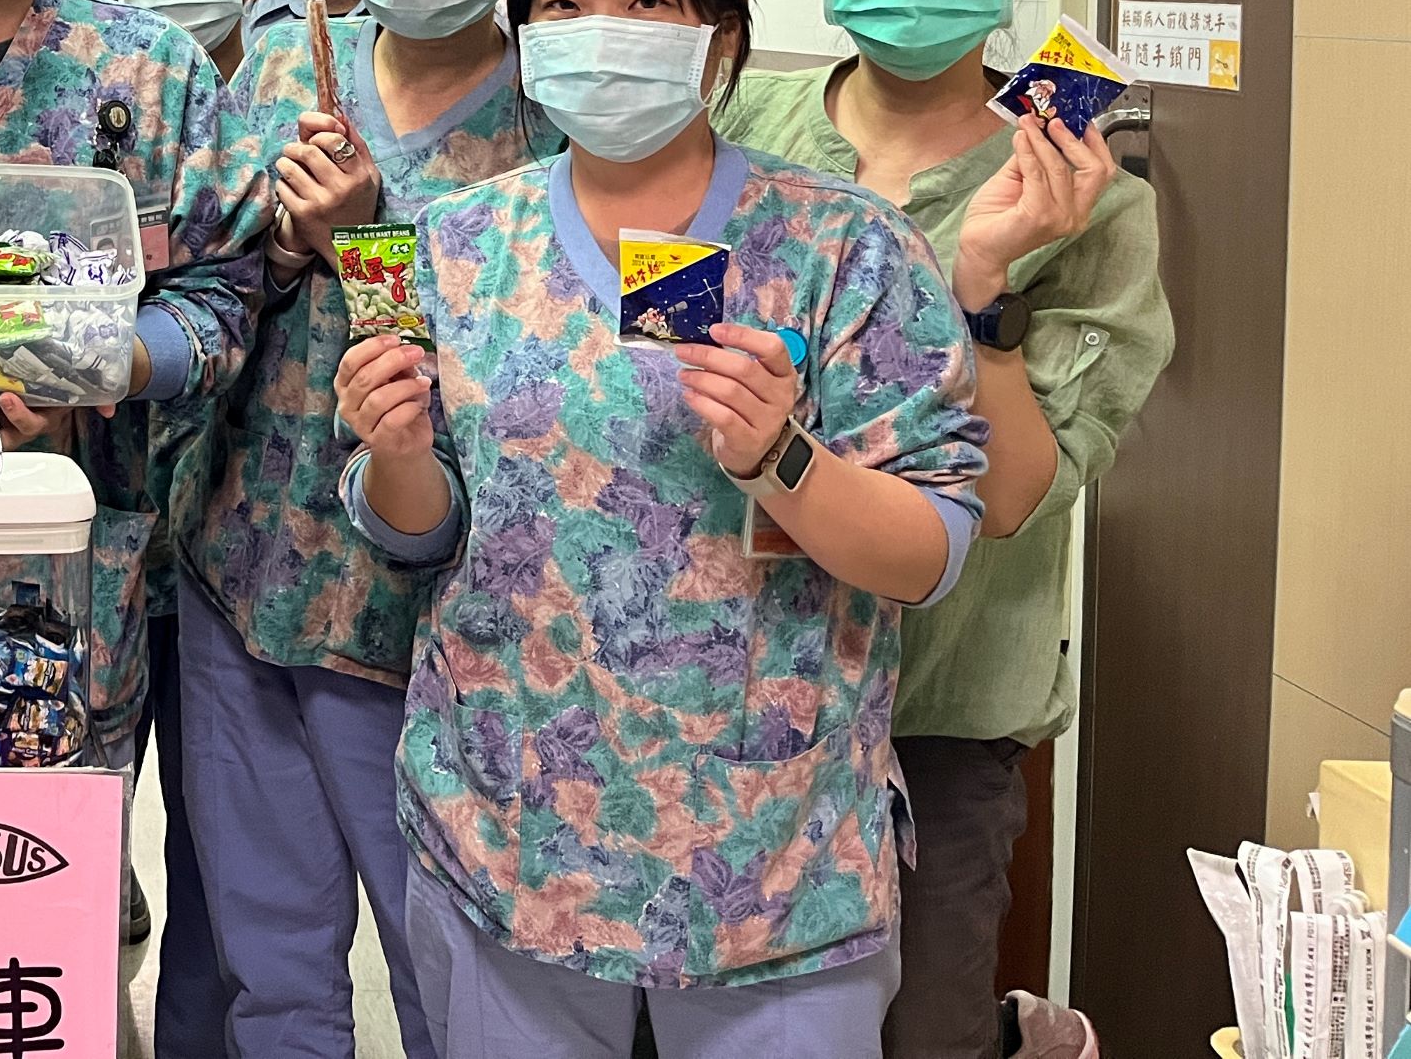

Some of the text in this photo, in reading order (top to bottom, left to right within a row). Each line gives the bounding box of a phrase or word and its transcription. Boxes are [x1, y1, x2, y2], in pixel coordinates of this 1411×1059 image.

[1120, 40, 1201, 71] 請隨手鎖門
